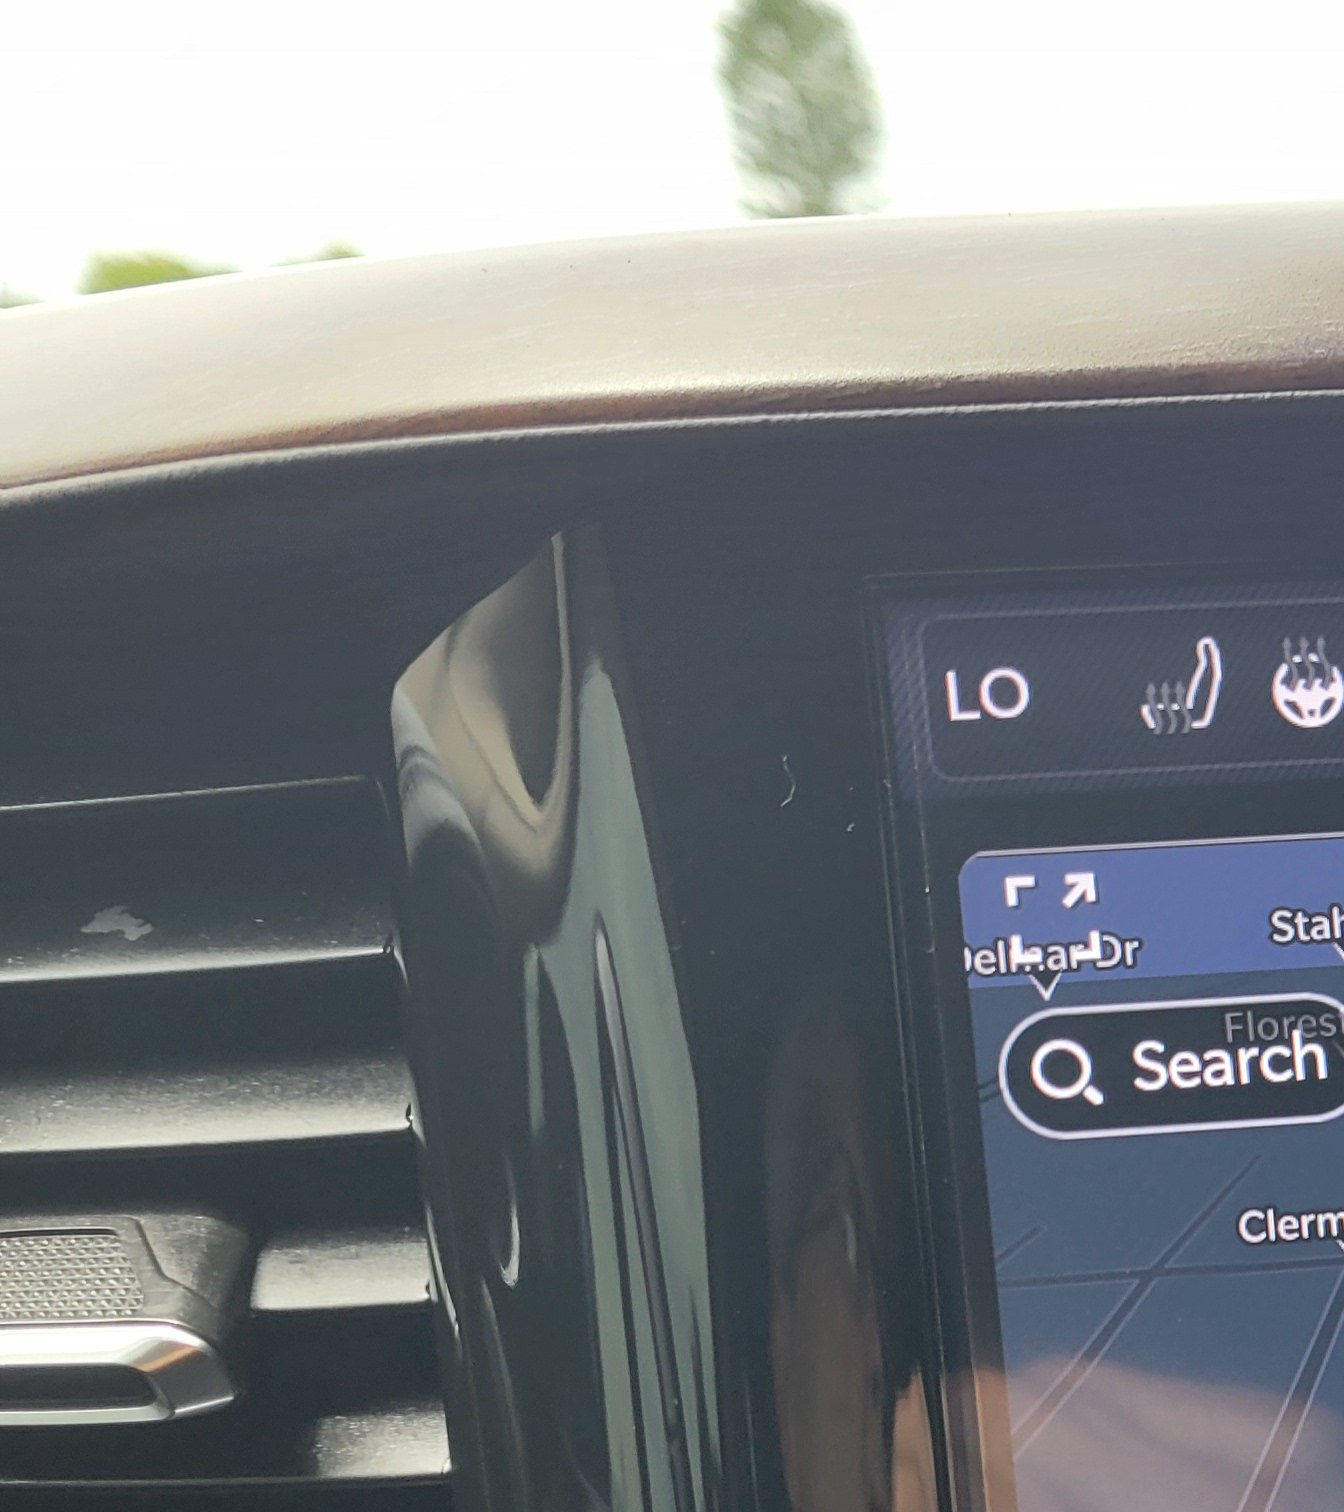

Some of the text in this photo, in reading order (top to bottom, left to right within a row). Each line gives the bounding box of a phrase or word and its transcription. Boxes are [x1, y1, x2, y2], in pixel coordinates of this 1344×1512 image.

[944, 667, 1031, 721] LO
[1098, 936, 1140, 969] Dr
[1131, 1033, 1328, 1092] Search
